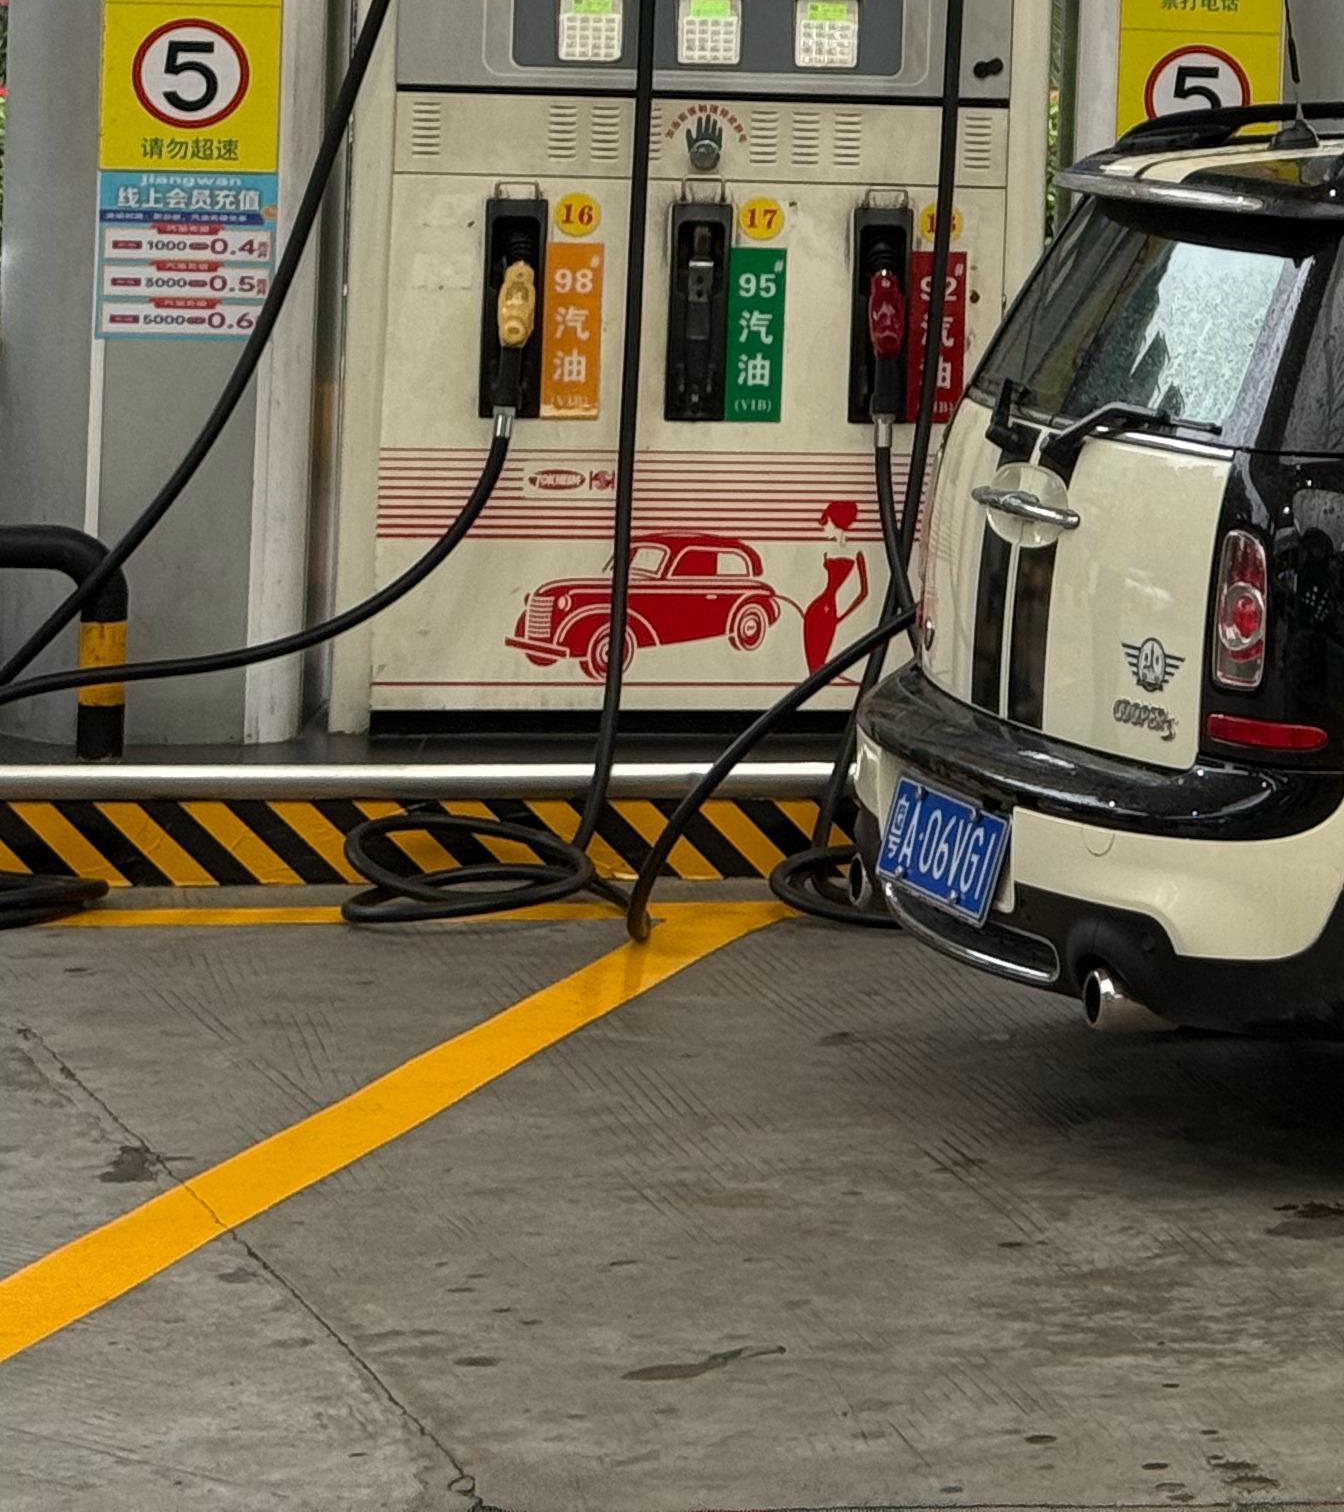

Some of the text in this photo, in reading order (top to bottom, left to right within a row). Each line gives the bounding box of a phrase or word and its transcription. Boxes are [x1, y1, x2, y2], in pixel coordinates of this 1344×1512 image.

[162, 39, 219, 113] 5
[1173, 65, 1223, 110] 5
[141, 136, 239, 162] 请勿超速
[116, 186, 261, 211] 线上会员充值
[561, 203, 593, 226] 16
[746, 207, 777, 231] 17
[147, 240, 187, 252] 1000
[210, 237, 256, 257] 0.4
[209, 274, 256, 293] 0.5
[554, 255, 600, 294] 98#
[738, 259, 784, 298] 95#
[207, 311, 254, 330] 0.6
[552, 305, 590, 384] 汽油
[737, 309, 774, 387] 汽油
